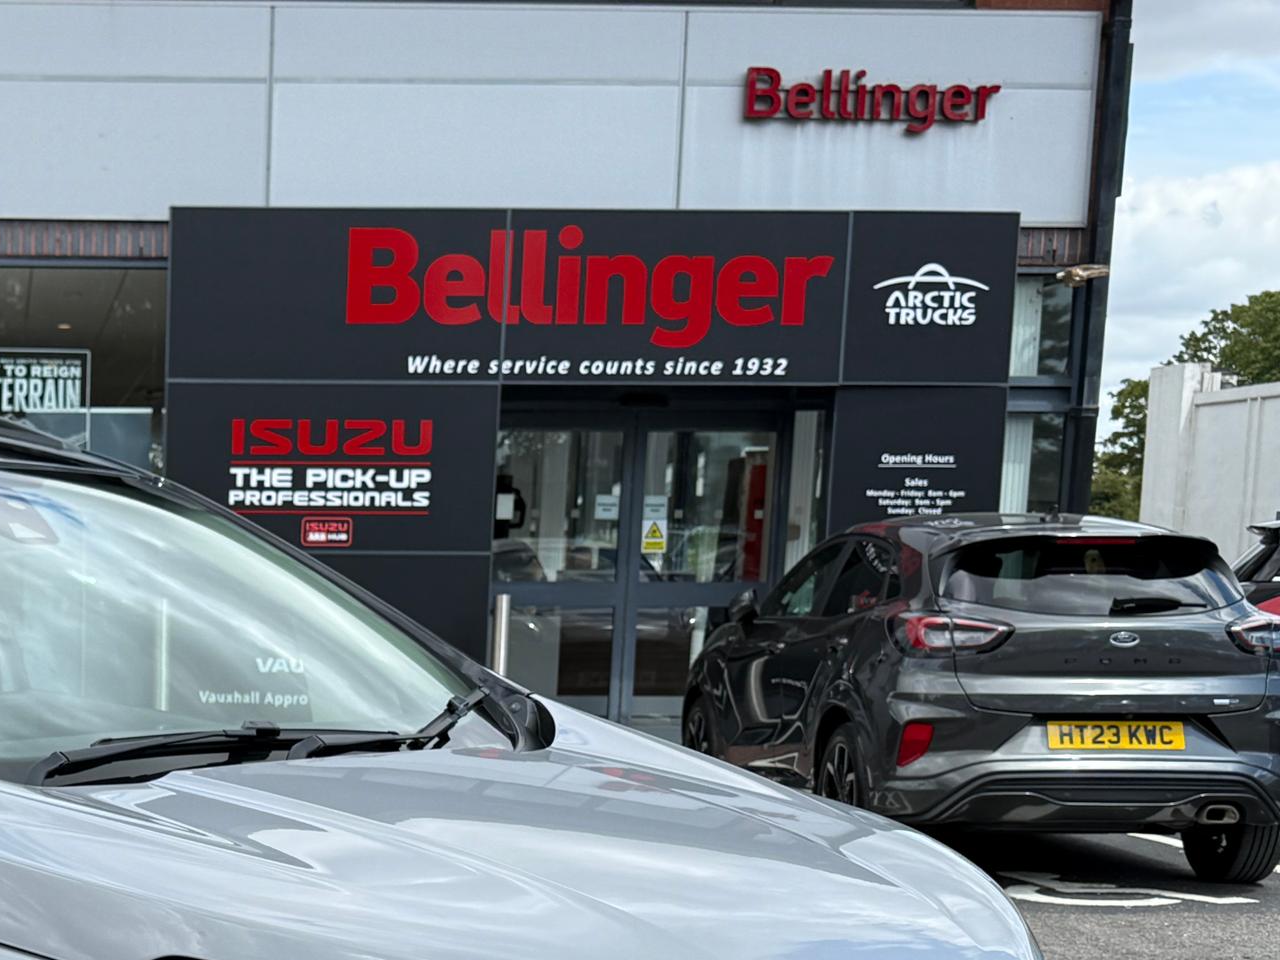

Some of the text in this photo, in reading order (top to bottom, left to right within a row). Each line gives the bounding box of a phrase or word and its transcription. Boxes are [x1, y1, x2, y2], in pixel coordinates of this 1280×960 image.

[744, 66, 1002, 134] Bellinger
[345, 225, 835, 348] Bellinger
[885, 290, 977, 308] ARCTIC
[884, 307, 977, 326] TRUCKS
[3, 365, 28, 377] TO
[30, 366, 82, 378] REIGN
[407, 355, 789, 376] Where service counts since 1932
[231, 419, 433, 456] ISUZU
[881, 453, 955, 465] Opening Hours
[229, 467, 432, 489] THE PICK-UP
[228, 490, 431, 508] PROFESSIONALS
[198, 690, 260, 705] Vauxhall
[1058, 724, 1174, 746] HT23 KWC
